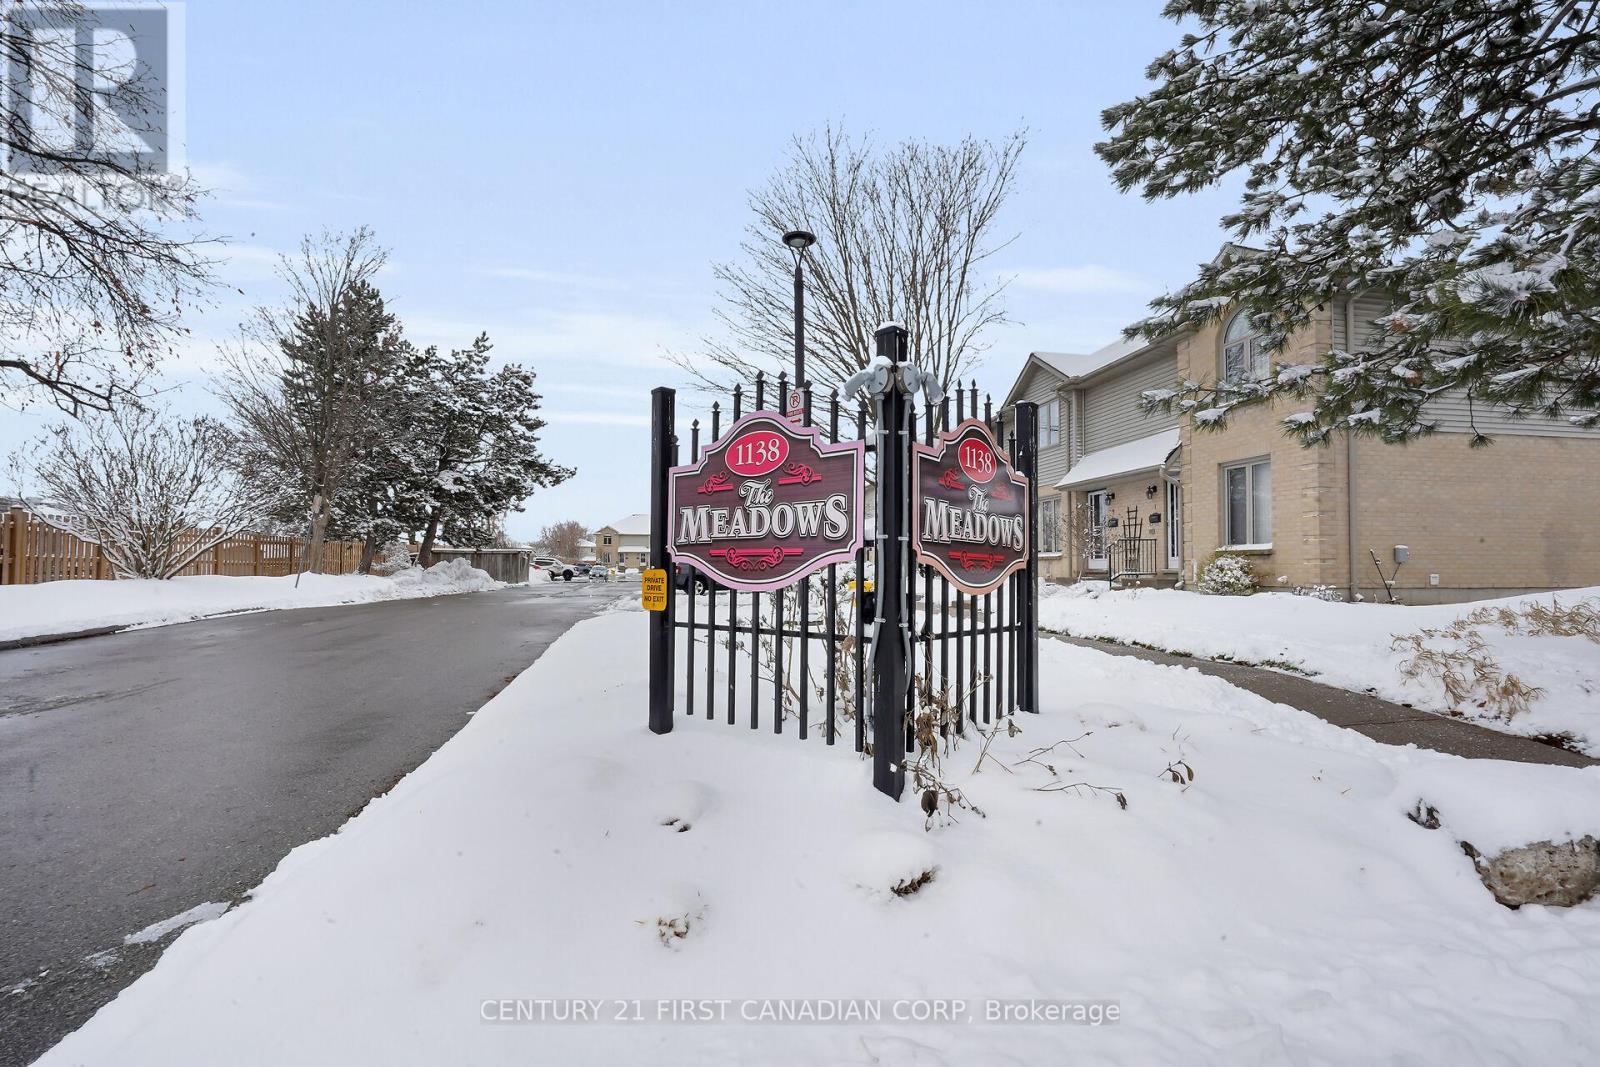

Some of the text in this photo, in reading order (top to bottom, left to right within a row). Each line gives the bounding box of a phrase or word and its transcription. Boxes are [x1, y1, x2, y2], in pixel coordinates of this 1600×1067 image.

[735, 438, 780, 467] 1138
[965, 446, 993, 474] 1138
[739, 478, 774, 508] The
[968, 484, 990, 514] The
[676, 493, 850, 545] MEADOWS
[922, 496, 1025, 552] MEADOWS
